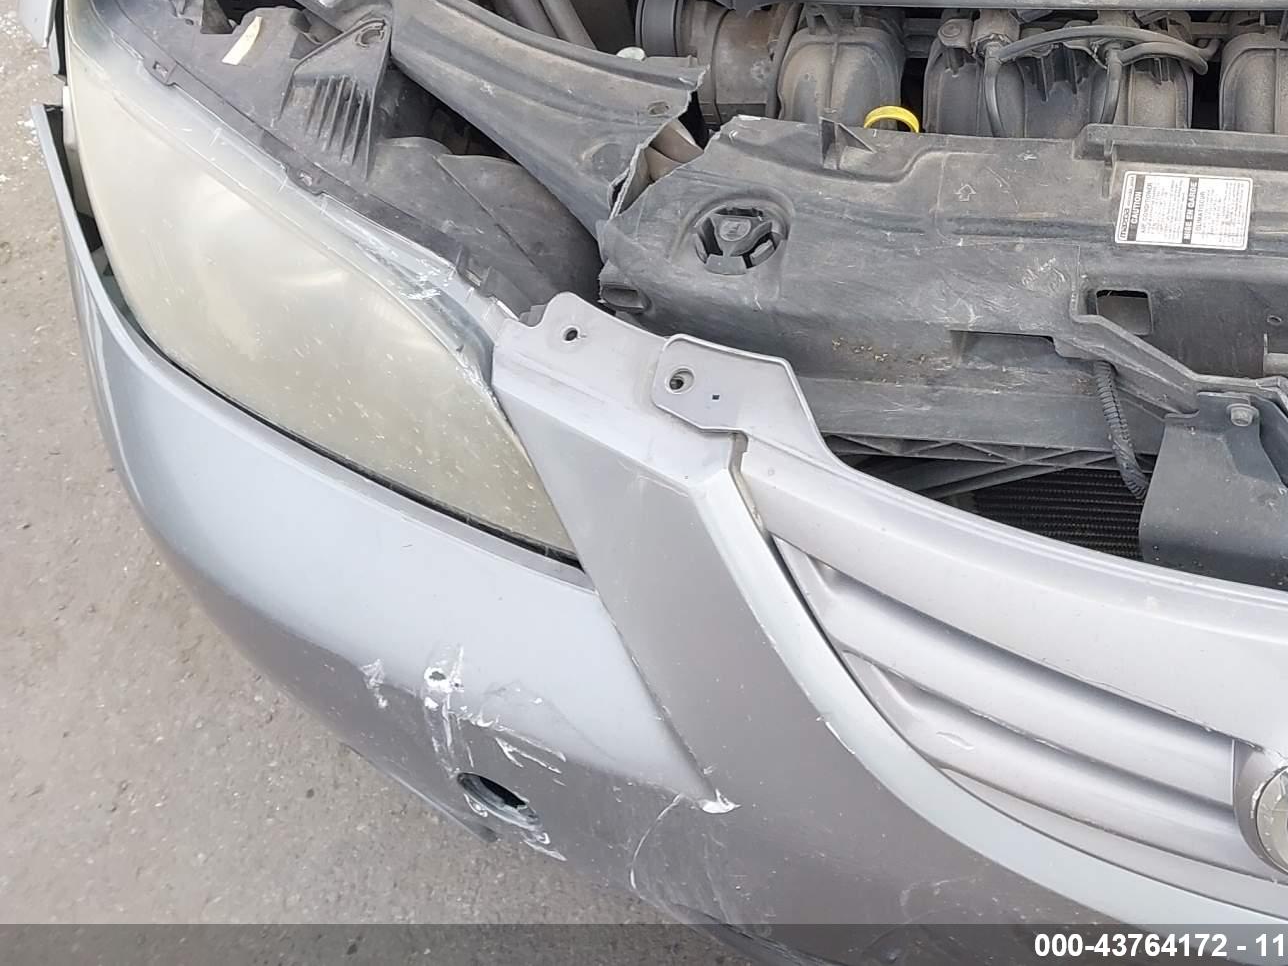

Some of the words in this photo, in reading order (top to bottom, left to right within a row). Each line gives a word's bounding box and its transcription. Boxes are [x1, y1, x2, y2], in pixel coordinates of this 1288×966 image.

[1130, 191, 1143, 225] CAUTION
[1142, 182, 1153, 223] CONDITIONER
[1186, 181, 1198, 209] GARDE
[1120, 208, 1130, 239] mazda
[1185, 208, 1195, 220] EN
[1183, 221, 1193, 240] MISE
